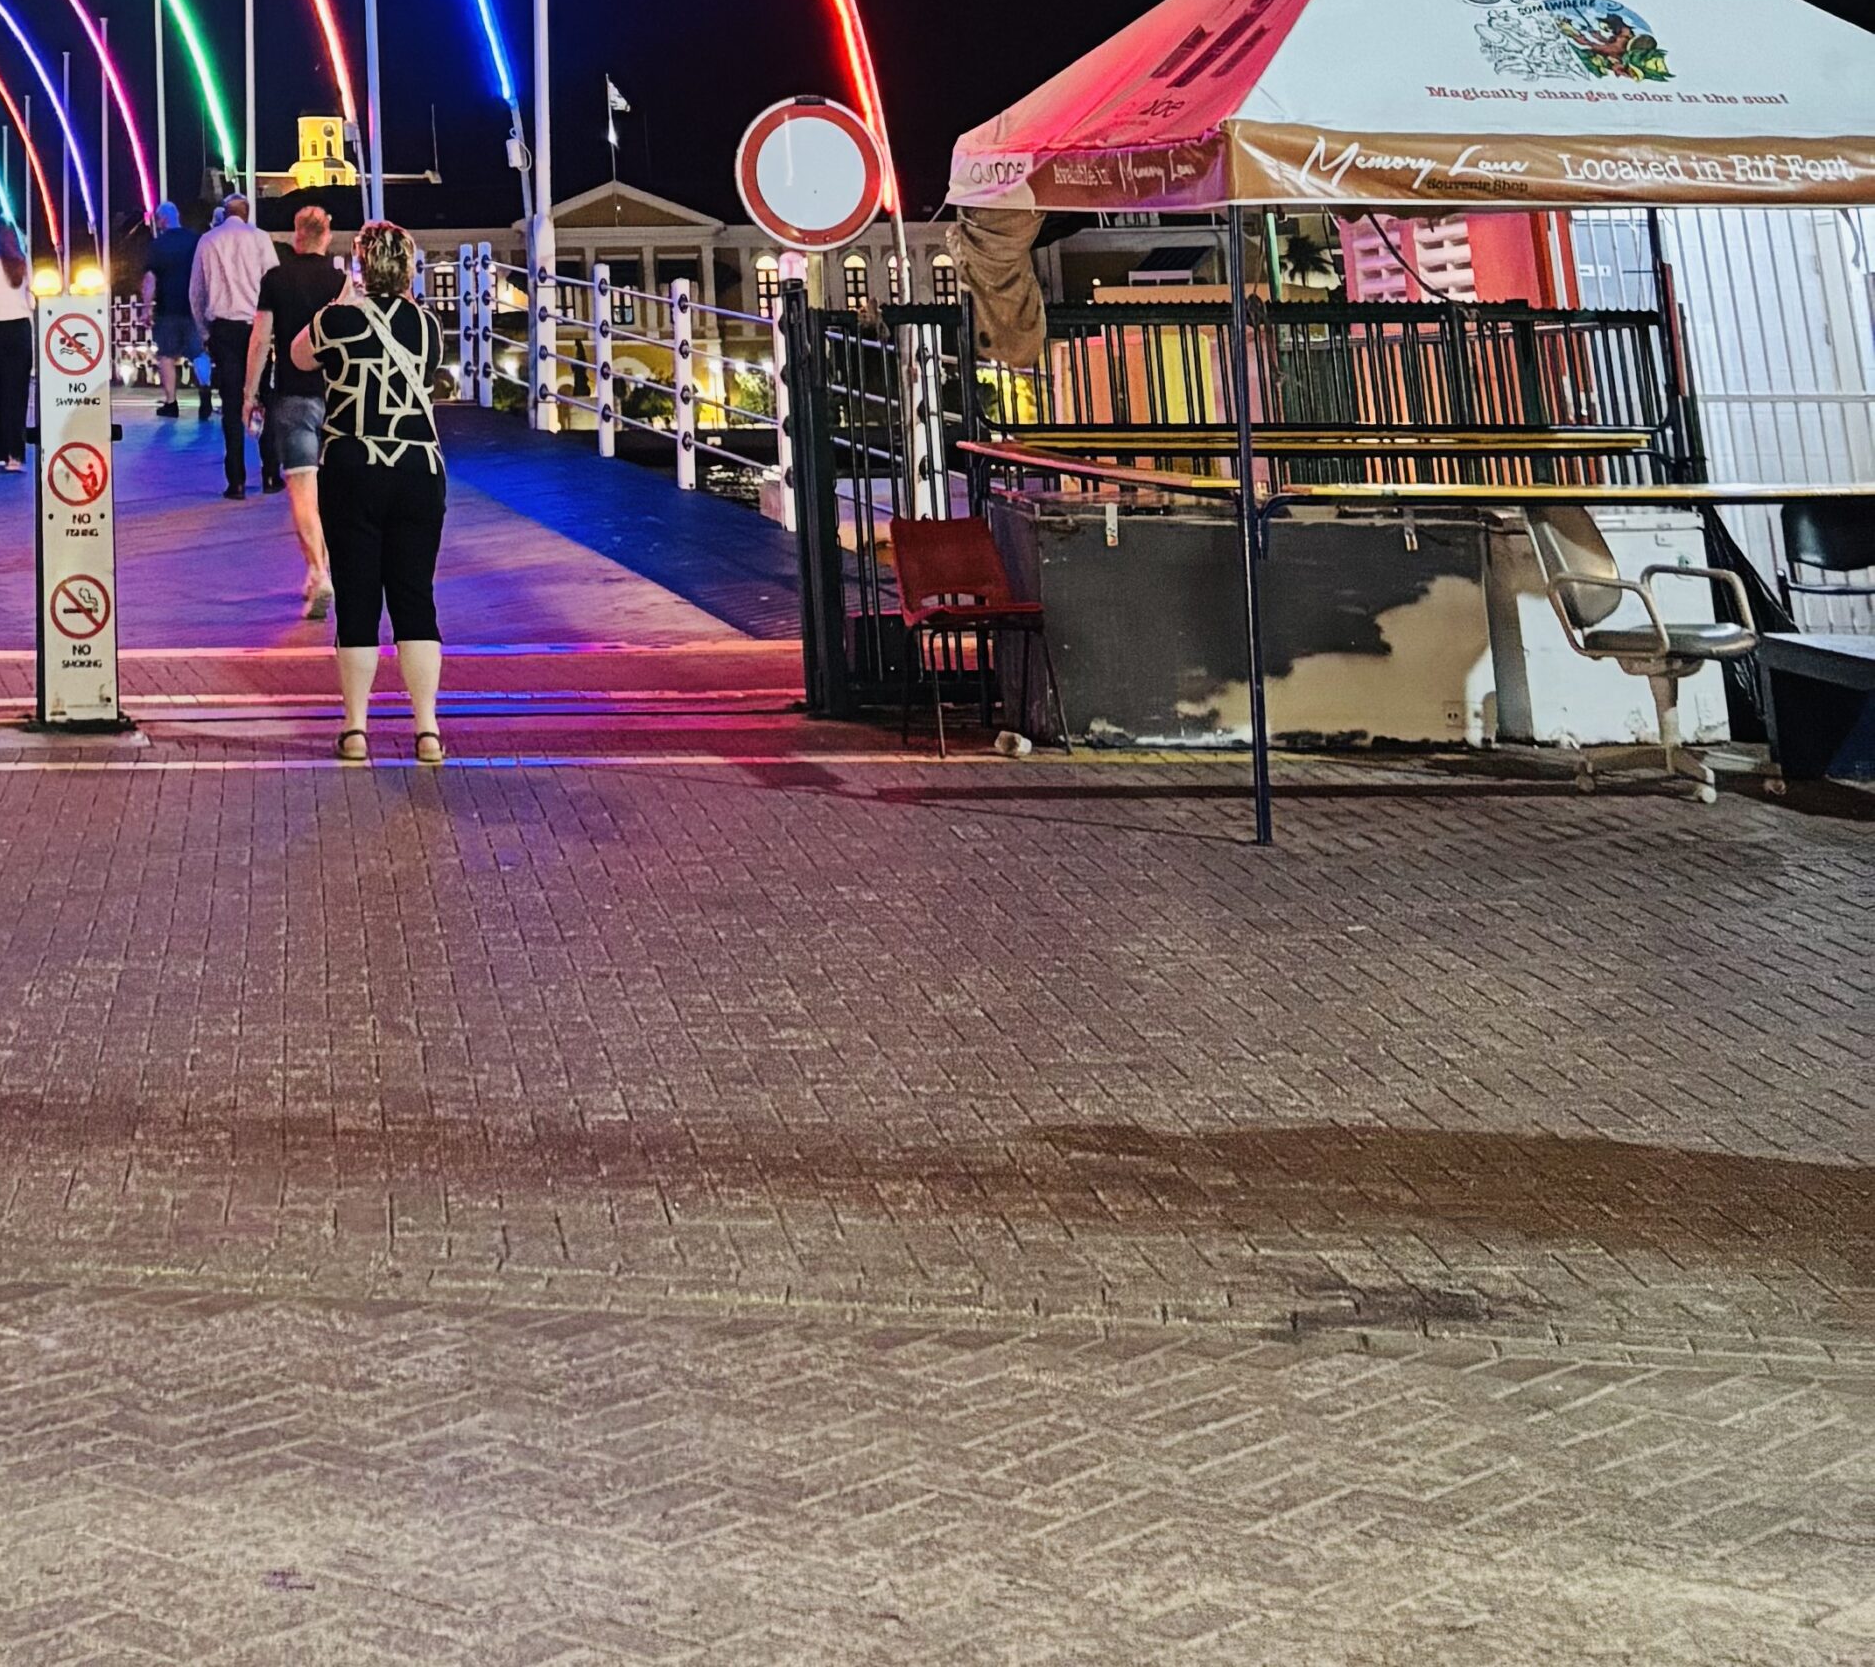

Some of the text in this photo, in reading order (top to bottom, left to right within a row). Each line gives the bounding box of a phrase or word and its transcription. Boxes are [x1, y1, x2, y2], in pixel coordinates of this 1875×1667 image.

[1518, 0, 1596, 16] SOMEWHERE
[1426, 86, 1789, 105] Magically changes color in the sun!
[1299, 135, 1529, 189] Memory Lane
[1558, 153, 1855, 183] Located in Rif Fort
[1426, 179, 1529, 194] Souvenir Shop
[68, 381, 87, 394] NO
[71, 513, 91, 525] NO
[65, 528, 99, 537] FISHING
[71, 643, 92, 656] NO
[61, 659, 103, 669] SMOKING
